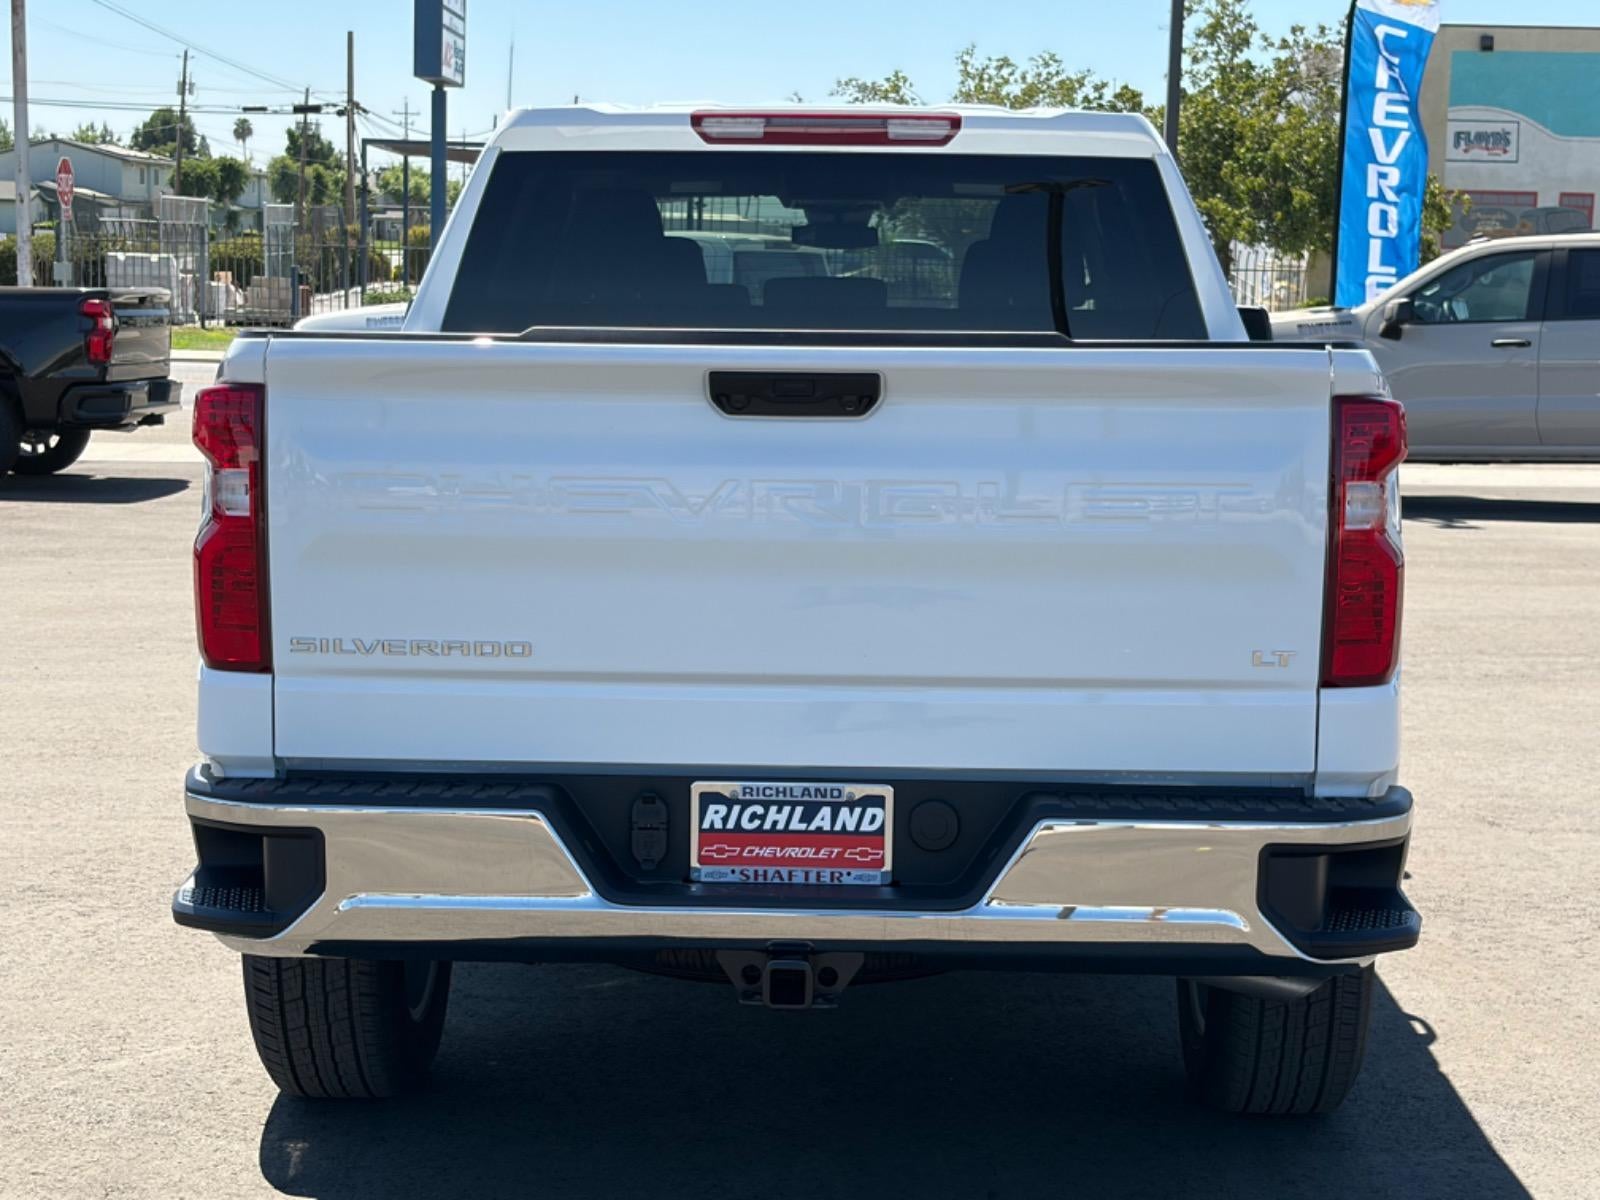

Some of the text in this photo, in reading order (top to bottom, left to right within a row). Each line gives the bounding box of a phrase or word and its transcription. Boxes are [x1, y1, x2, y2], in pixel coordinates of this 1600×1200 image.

[1365, 23, 1411, 304] CHEVROLE
[57, 174, 74, 191] STOP
[289, 636, 533, 658] SILVERADO
[1251, 650, 1297, 668] LT
[741, 785, 843, 800] RICHLAND
[701, 803, 886, 832] RICHLAND
[742, 846, 843, 859] CHEVROLET
[738, 867, 844, 884] SHAFTER
